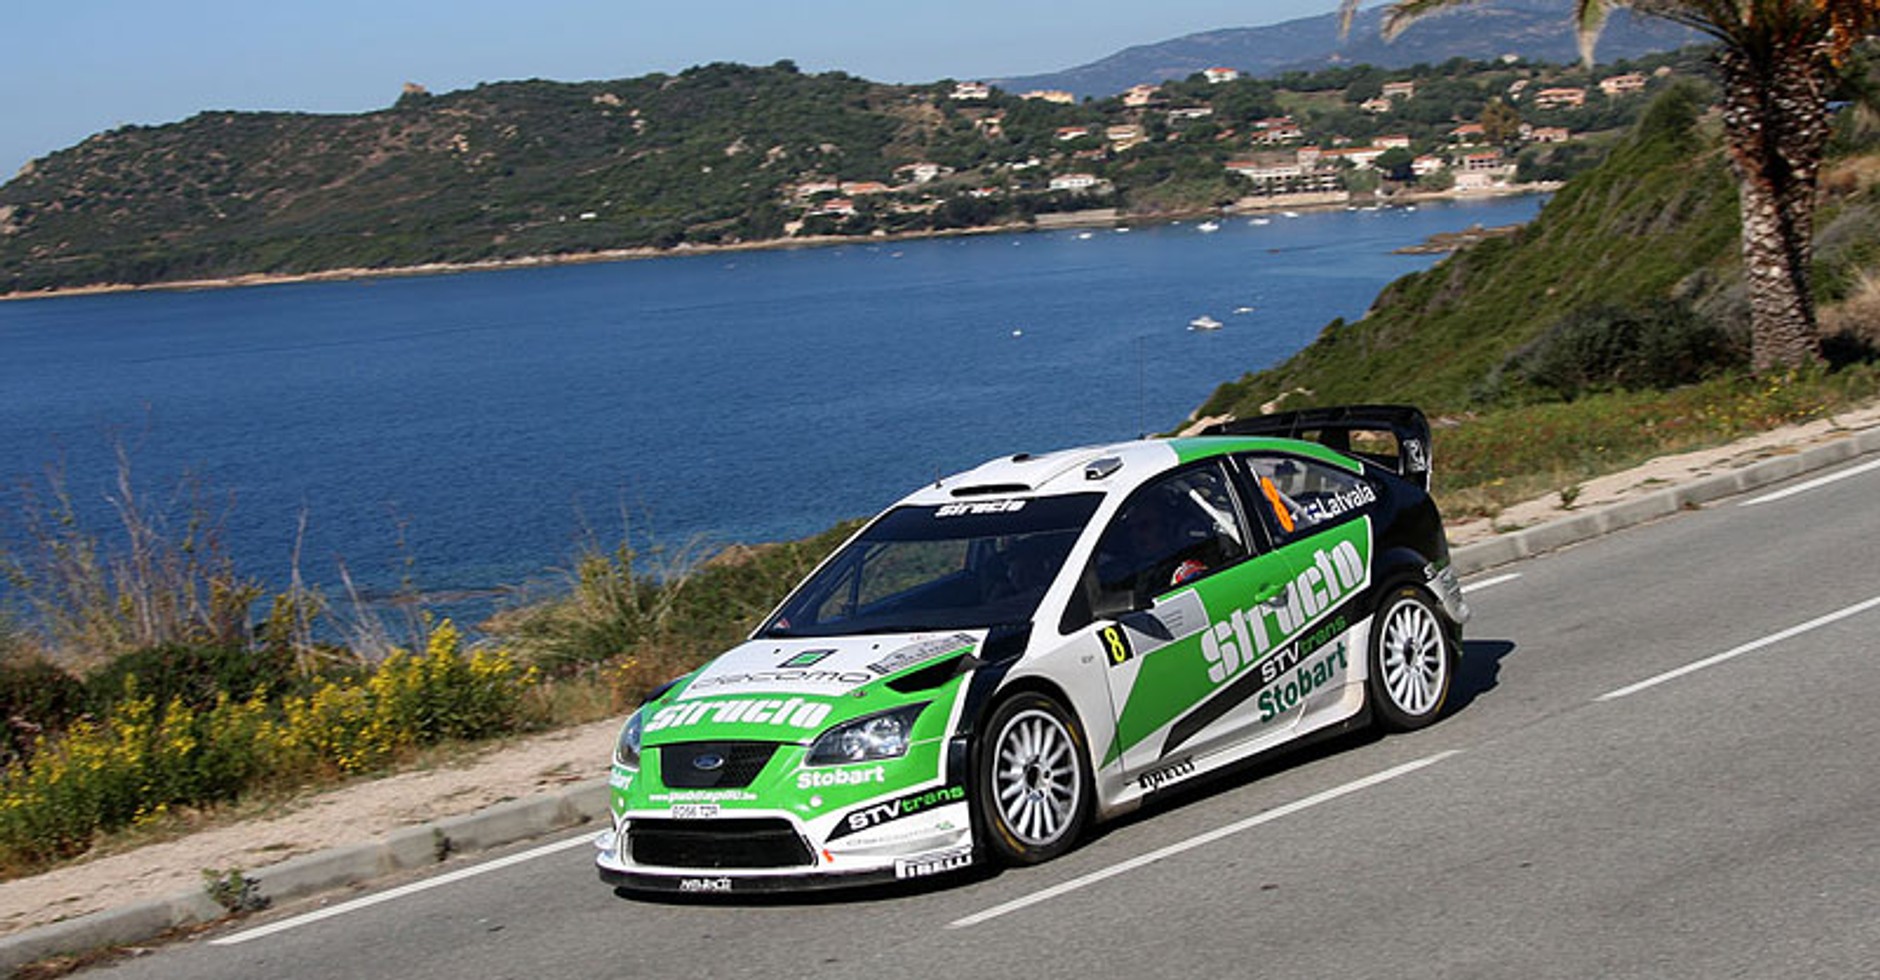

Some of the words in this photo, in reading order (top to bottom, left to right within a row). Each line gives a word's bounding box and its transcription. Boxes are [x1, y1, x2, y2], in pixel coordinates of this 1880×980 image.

[1201, 540, 1365, 684] structo
[1104, 626, 1126, 662] 8
[1258, 641, 1348, 723] Stobart
[643, 697, 833, 734] structo
[797, 766, 886, 789] Stobart
